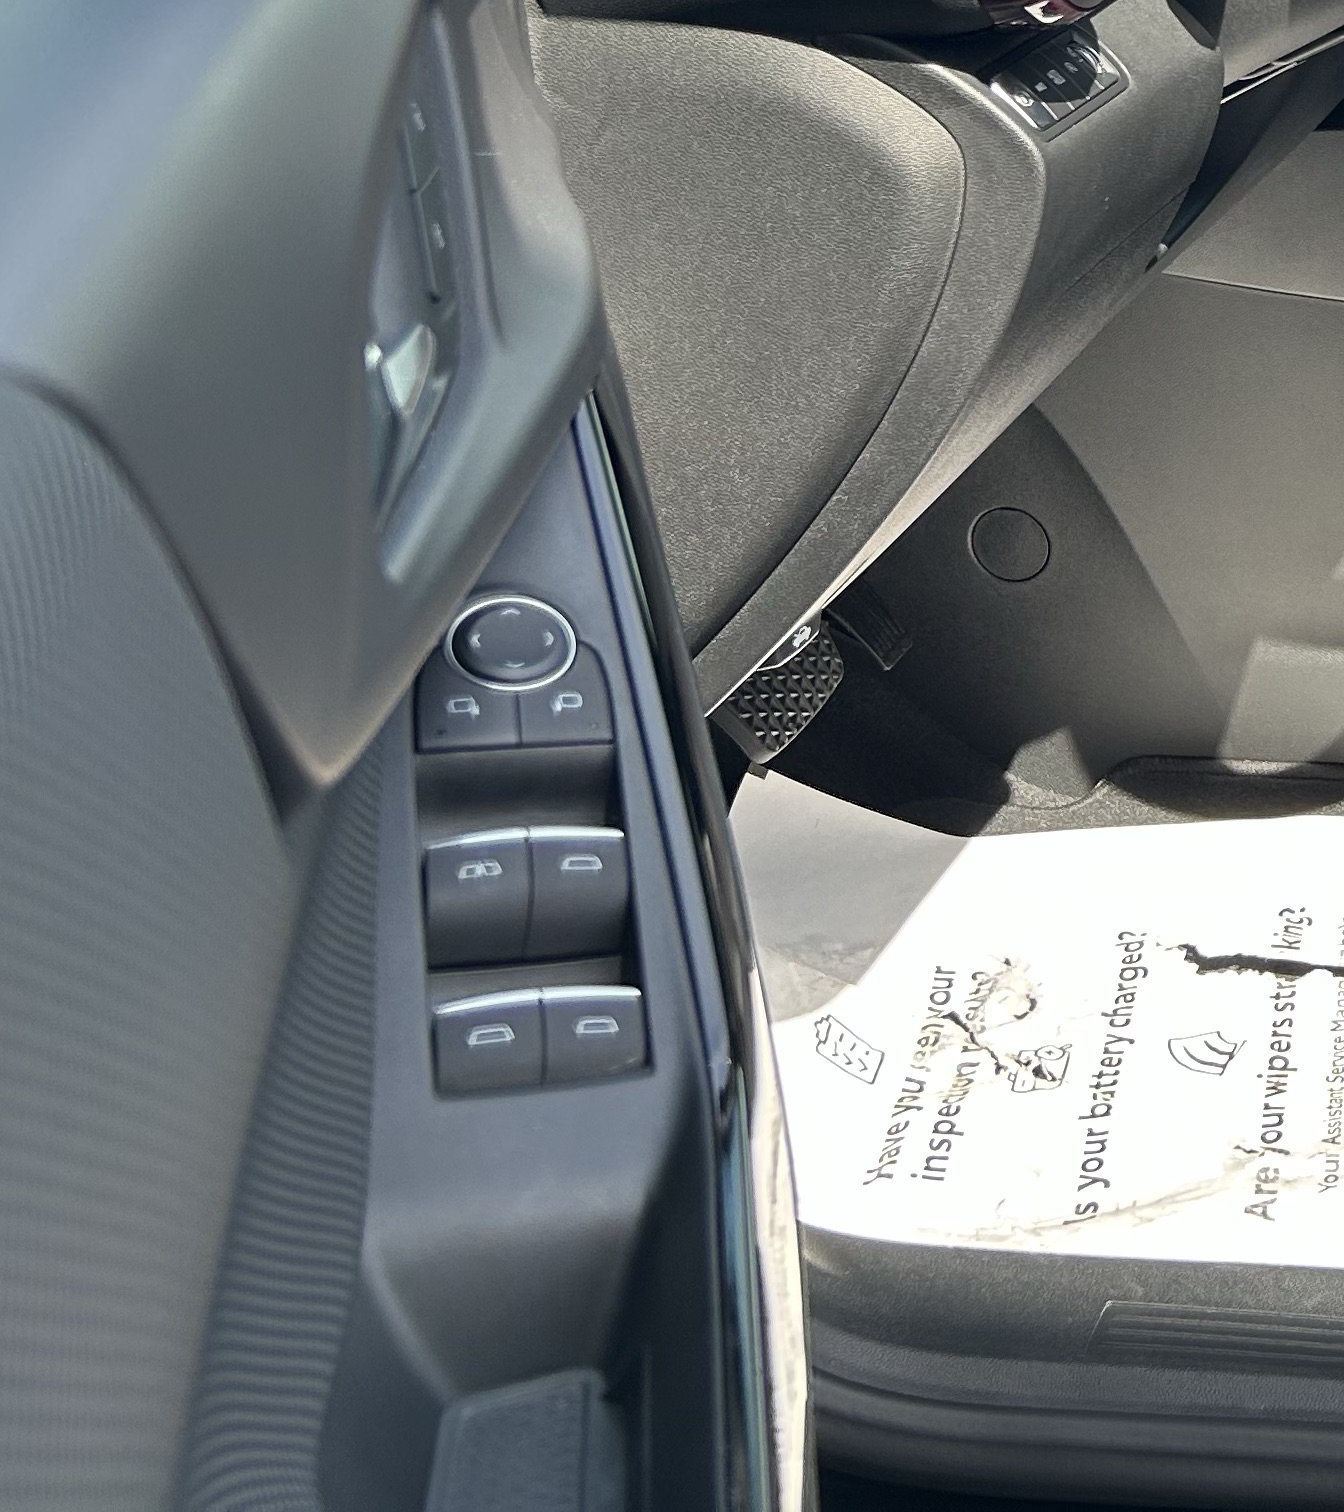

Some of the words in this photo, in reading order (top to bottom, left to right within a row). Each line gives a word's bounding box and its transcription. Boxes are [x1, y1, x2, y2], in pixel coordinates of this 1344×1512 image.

[1101, 930, 1147, 1029] charged?
[1079, 1032, 1135, 1121] battery
[1257, 1019, 1296, 1098] wipers
[863, 1120, 910, 1186] Have
[896, 1077, 927, 1117] you
[1078, 1129, 1110, 1192] your
[1063, 1201, 1098, 1225] Is
[1244, 1161, 1280, 1221] Are
